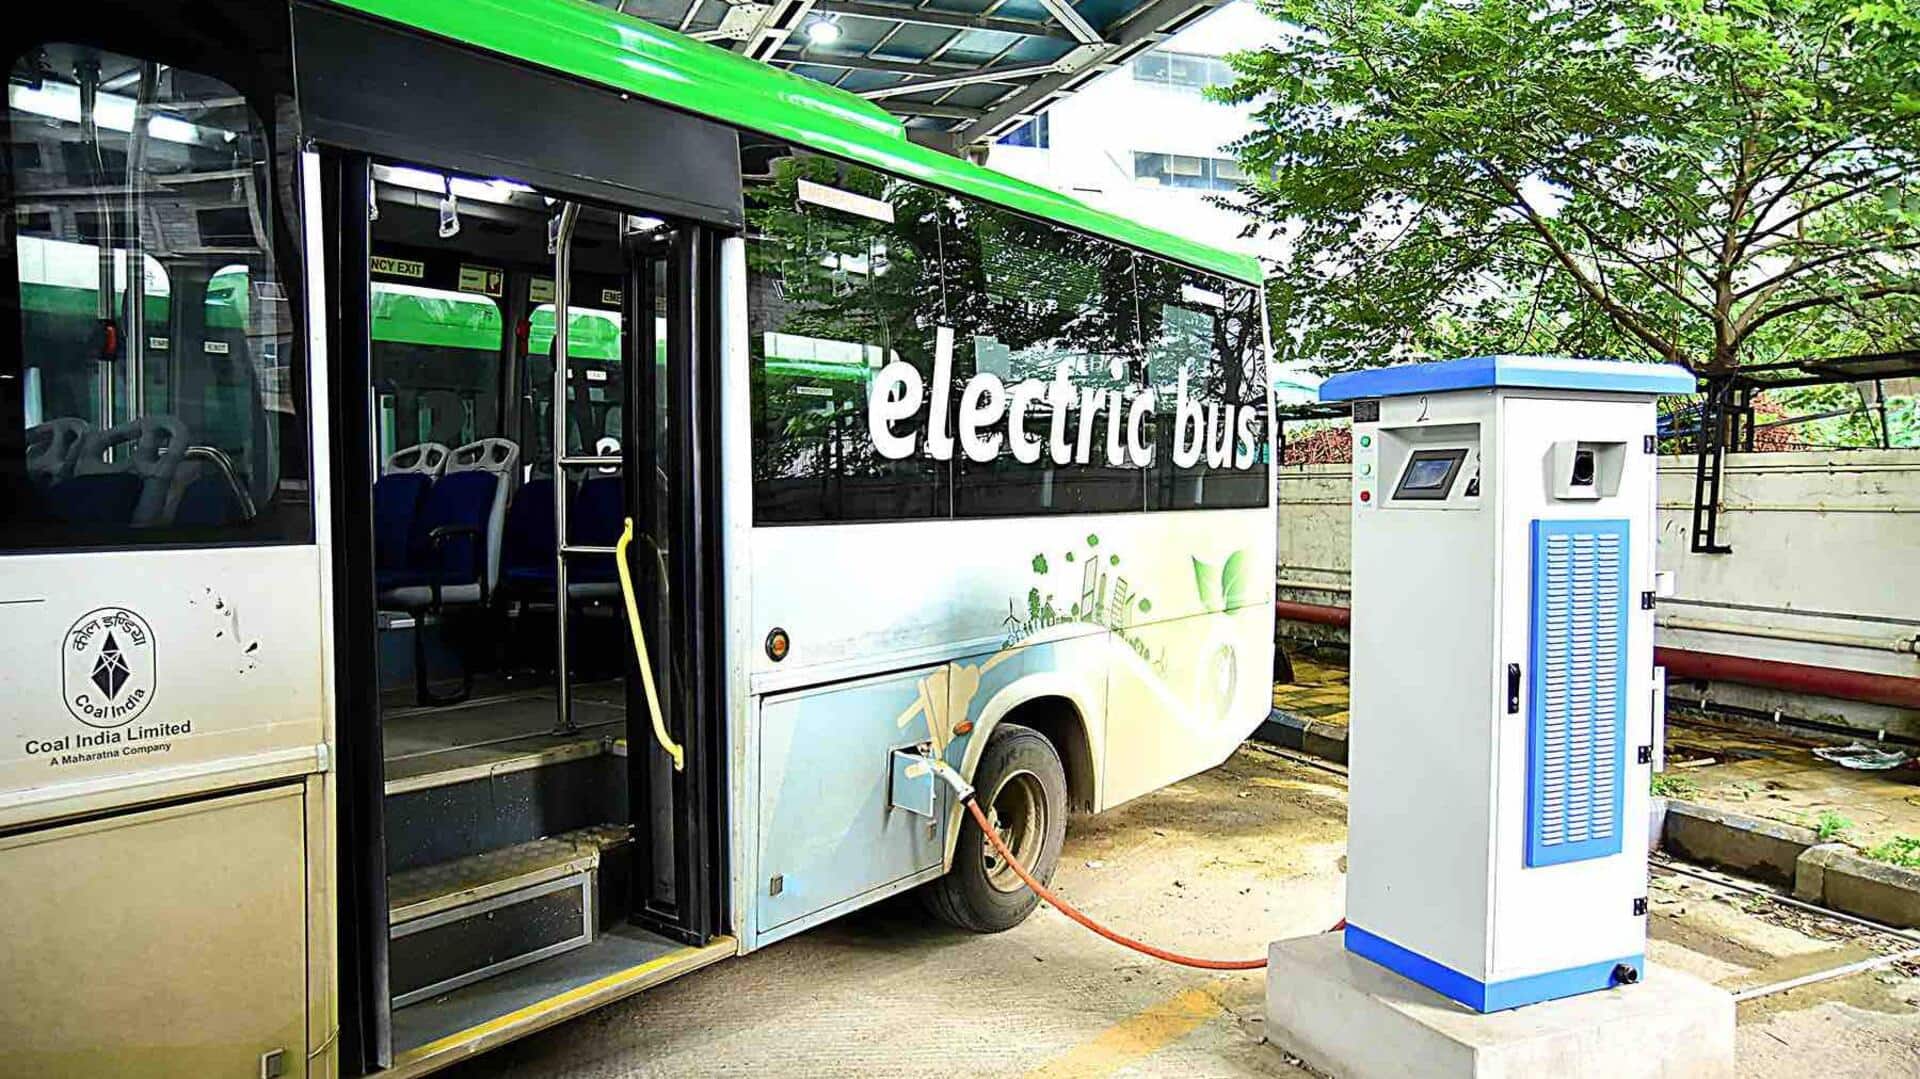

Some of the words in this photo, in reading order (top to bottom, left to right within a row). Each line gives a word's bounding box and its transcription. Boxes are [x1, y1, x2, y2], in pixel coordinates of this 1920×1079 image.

[397, 261, 422, 275] EXIT
[868, 327, 1155, 467] electric
[1172, 366, 1259, 470] bus
[1416, 395, 1430, 422] 2
[72, 620, 101, 651] कोल
[75, 694, 108, 719] Coal
[111, 688, 145, 719] India
[25, 736, 70, 755] Coal
[76, 731, 121, 748] India
[127, 720, 192, 741] Limited
[50, 757, 59, 766] A
[61, 749, 120, 765] Maharatna
[122, 742, 172, 757] Company
